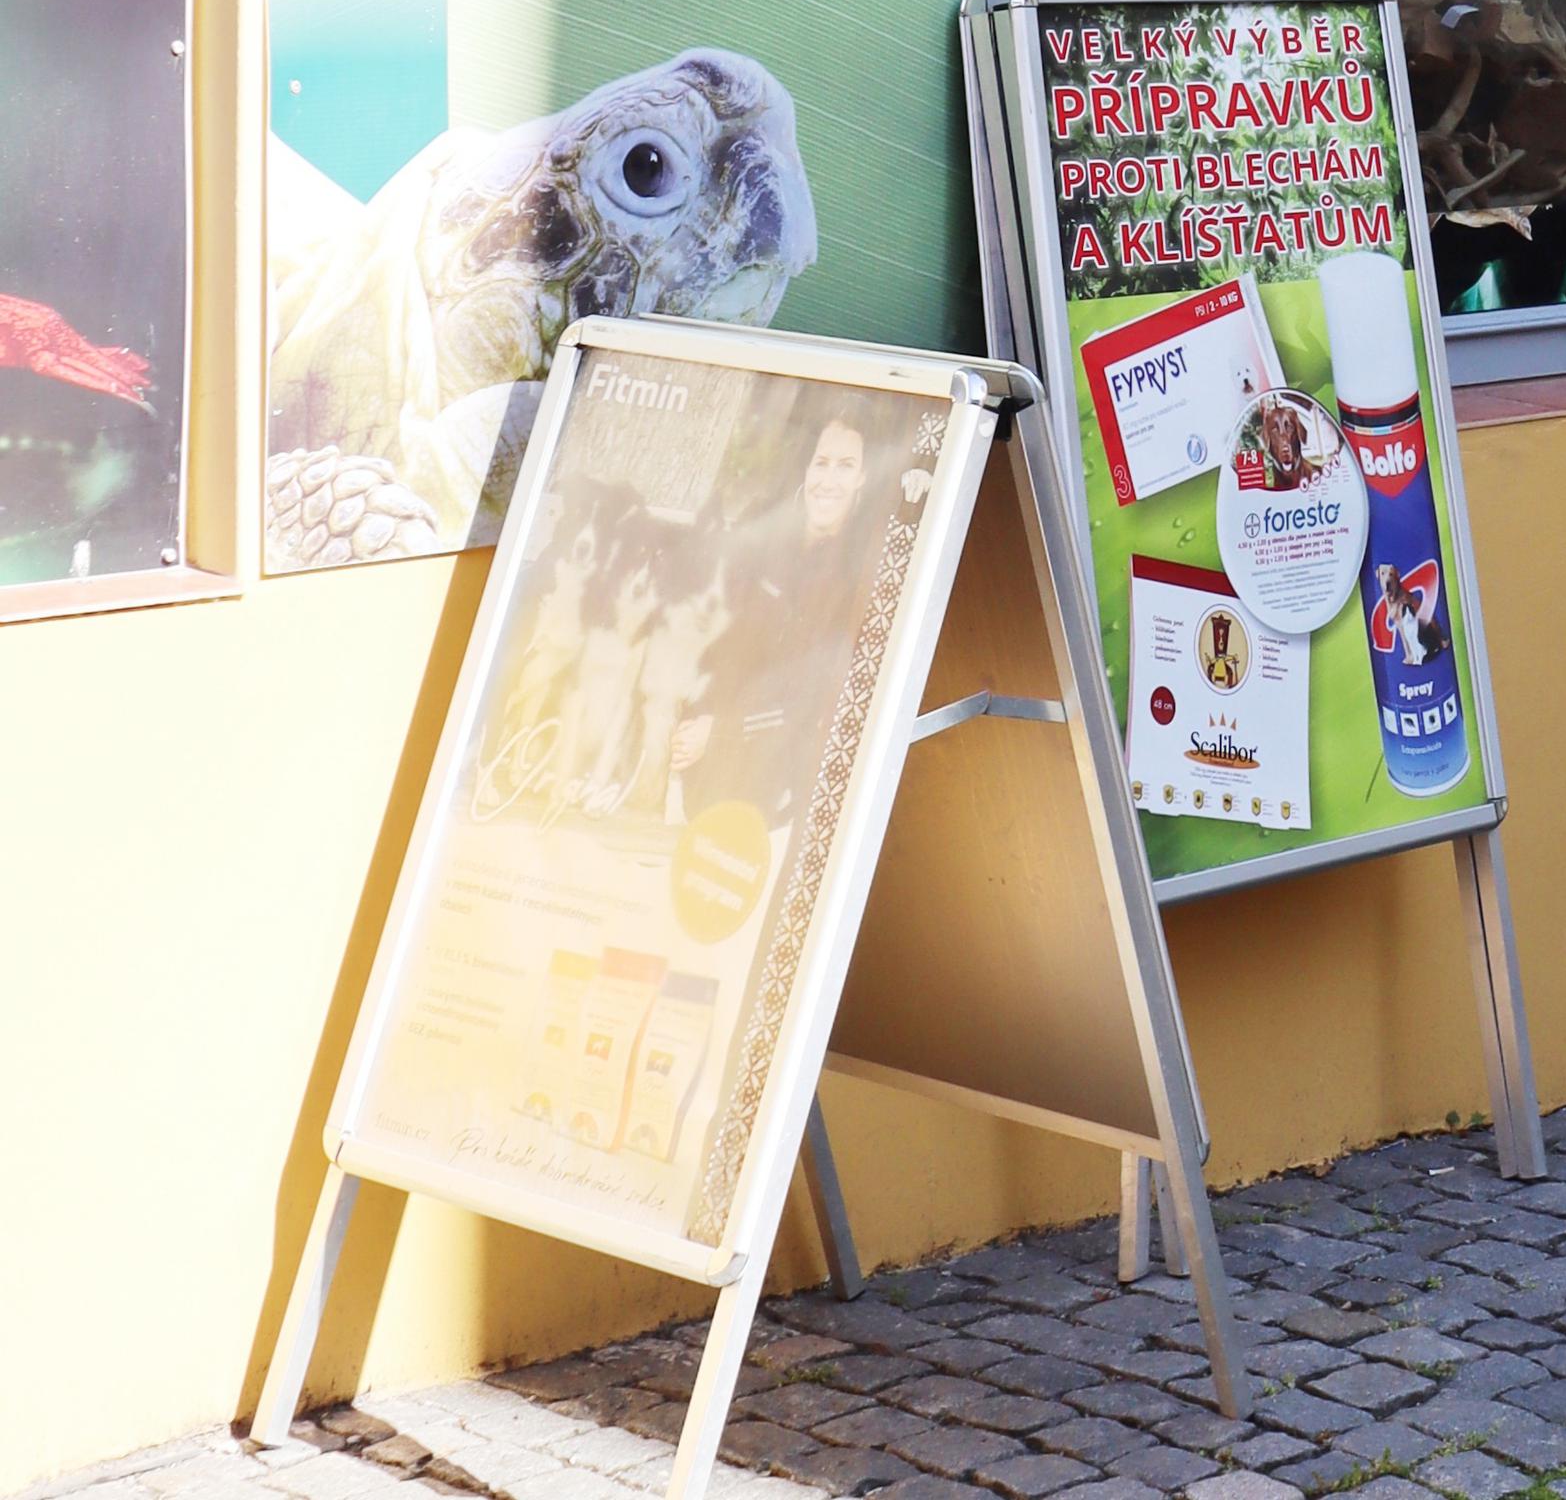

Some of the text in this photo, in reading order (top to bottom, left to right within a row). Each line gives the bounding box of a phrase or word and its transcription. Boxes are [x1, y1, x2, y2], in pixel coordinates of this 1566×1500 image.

[1046, 18, 1365, 62] VELKÝ VÝBĚR
[1053, 61, 1375, 138] PŘÍPRAVKŮ
[1062, 140, 1383, 198] PROTI BLECHÁM
[1072, 195, 1393, 269] A KLÍŠŤATŮM
[586, 363, 689, 413] Fitmin
[1111, 346, 1187, 402] FYPRYST
[1114, 464, 1131, 499] 3
[1359, 442, 1416, 477] Bolfo
[1264, 500, 1340, 534] foresto
[1398, 680, 1434, 701] Spray
[1190, 731, 1258, 764] Scalibor
